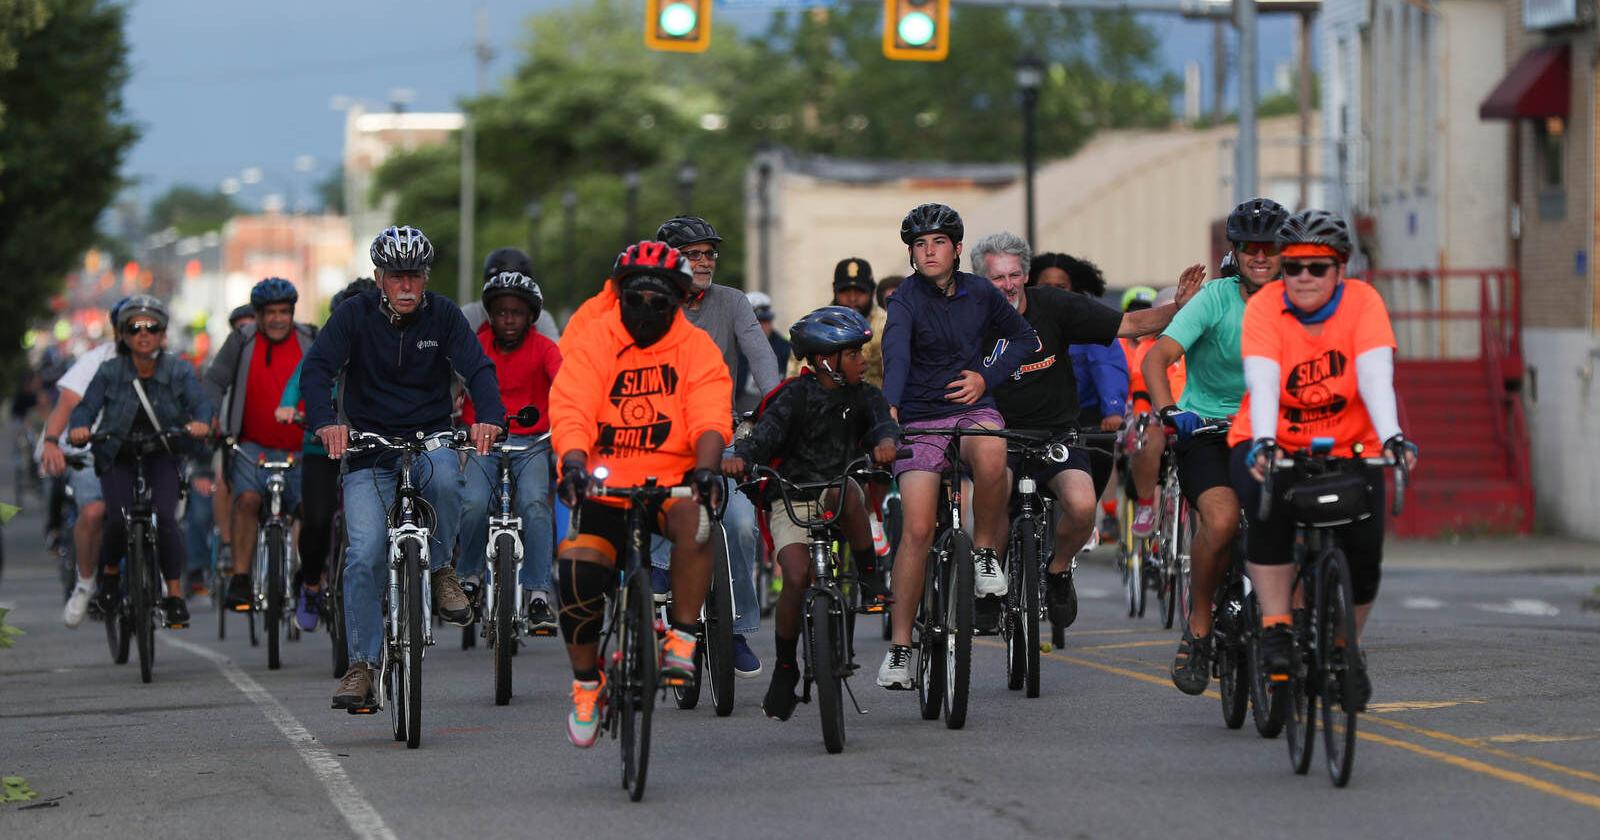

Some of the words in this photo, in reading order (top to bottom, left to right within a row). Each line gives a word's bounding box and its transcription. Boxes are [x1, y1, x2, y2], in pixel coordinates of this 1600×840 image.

[621, 367, 663, 396] SLOW
[1296, 352, 1332, 386] SLOW
[614, 427, 656, 449] ROLL
